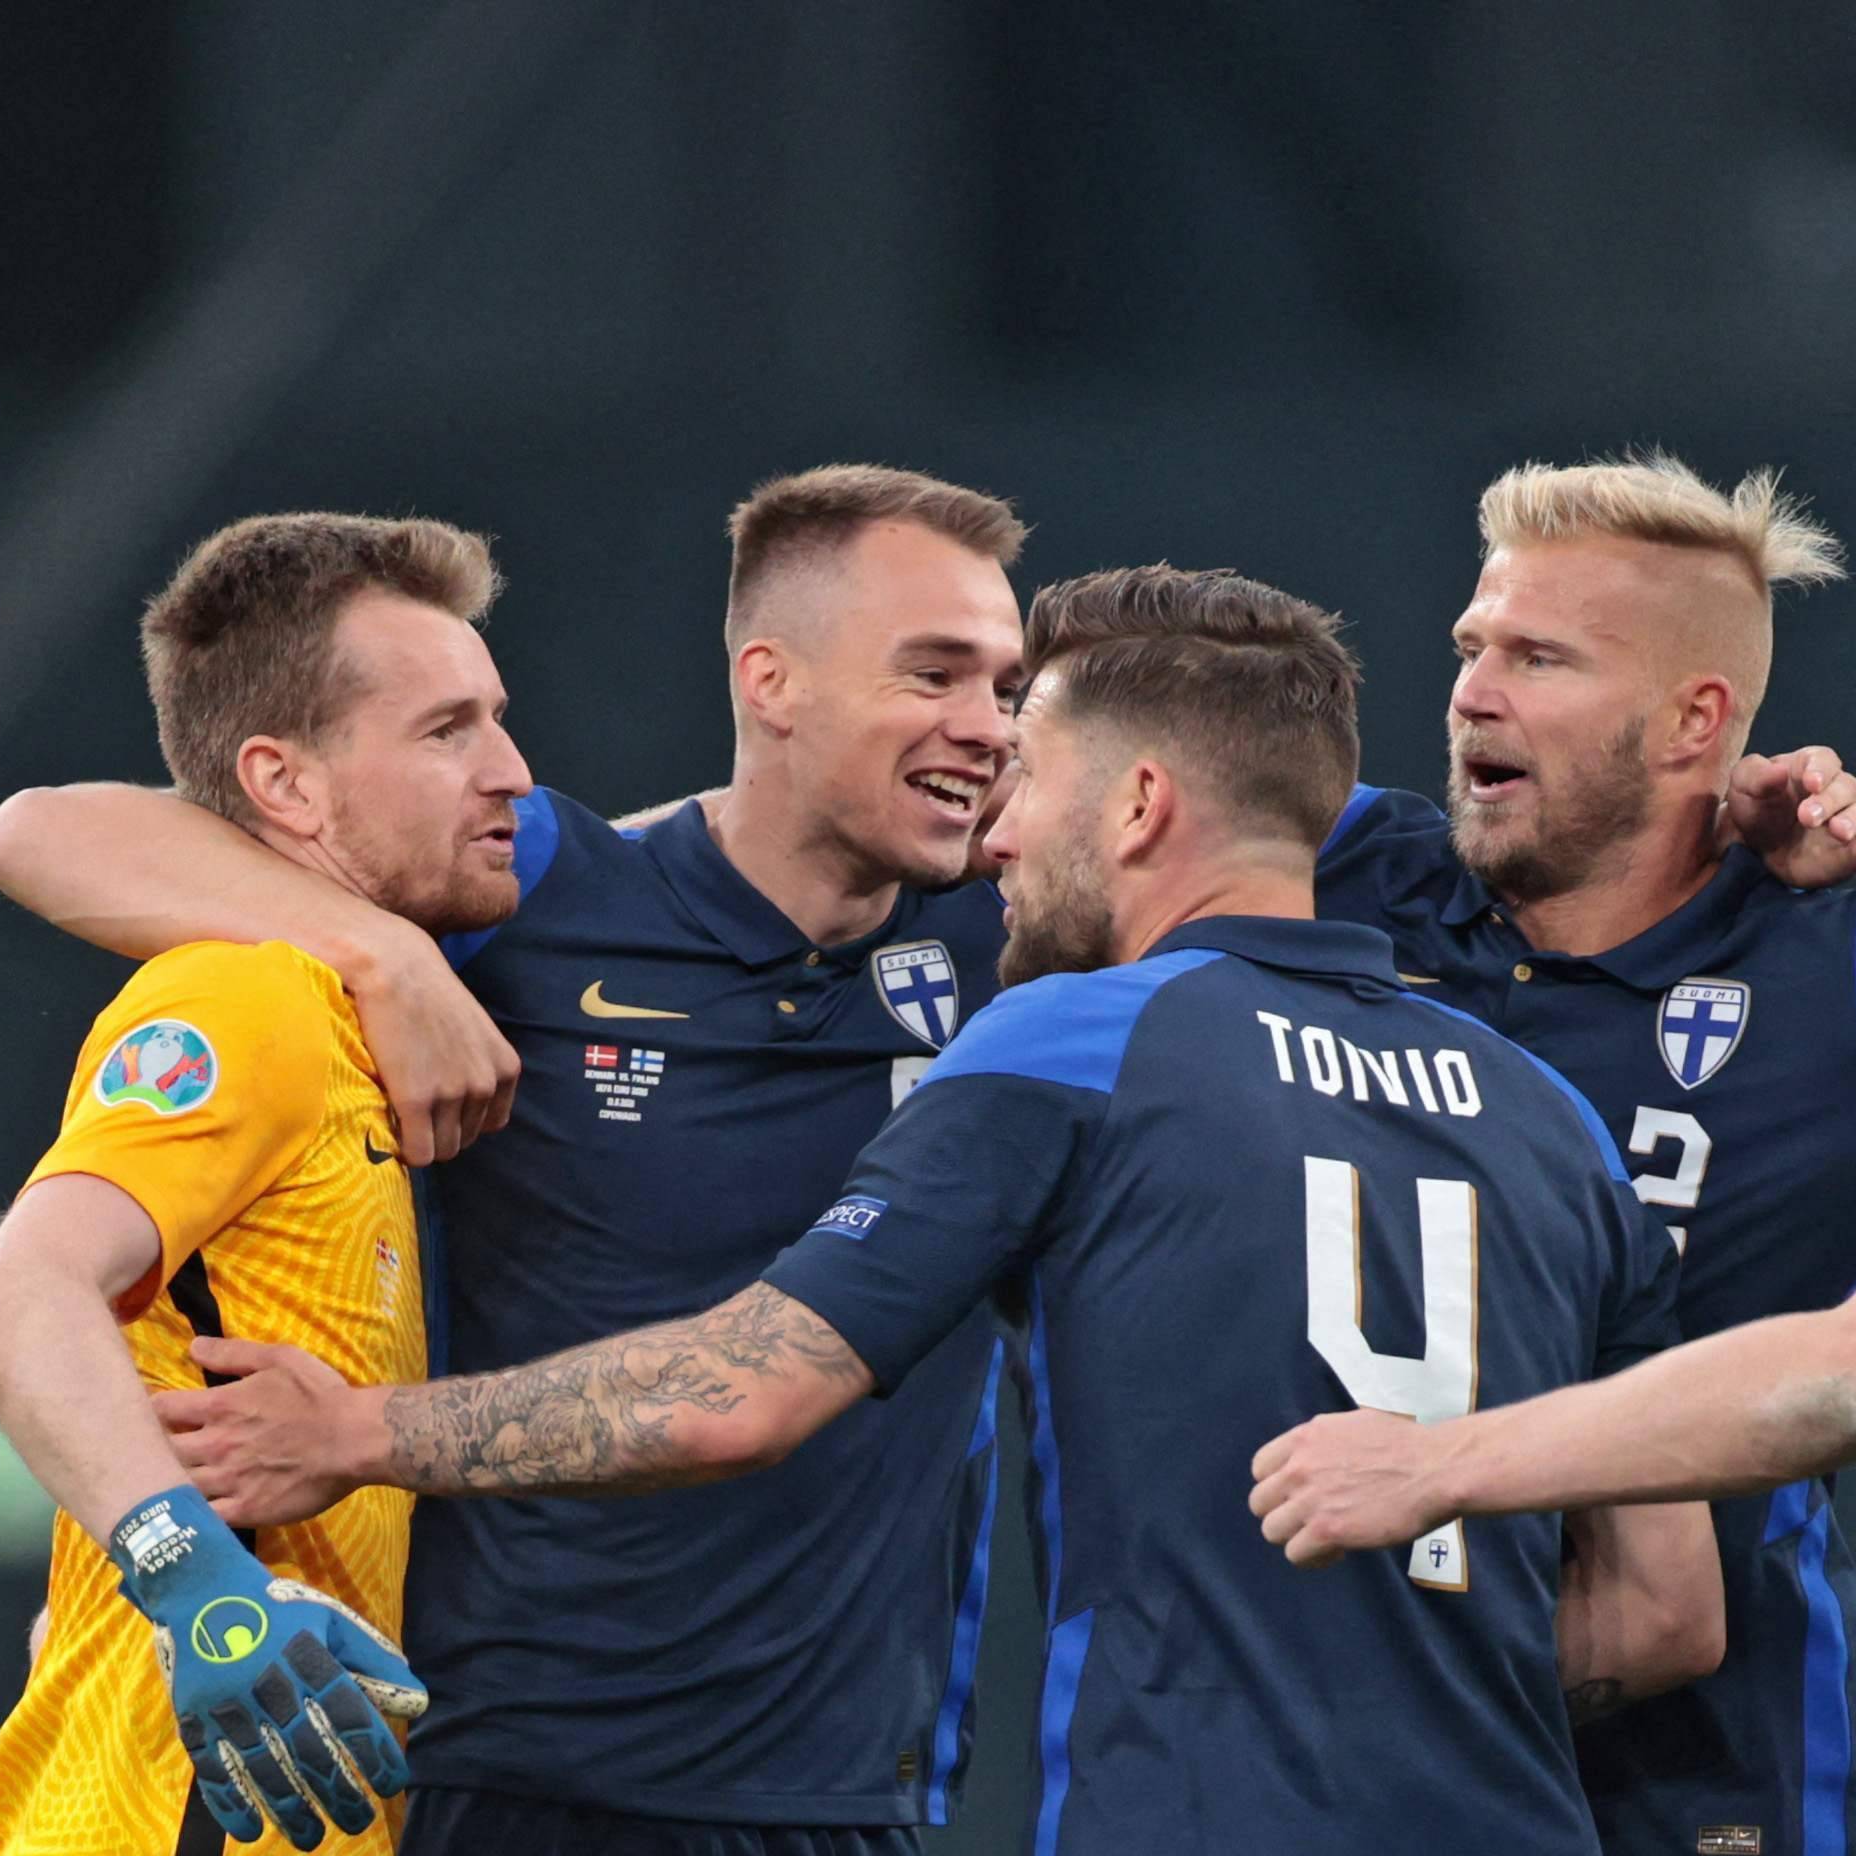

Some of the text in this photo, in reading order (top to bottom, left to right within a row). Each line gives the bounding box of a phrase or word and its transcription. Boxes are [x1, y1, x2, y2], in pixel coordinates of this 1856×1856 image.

[887, 951, 939, 967] SUOMI
[1679, 988, 1736, 1000] SUOMI
[814, 1205, 880, 1228] SPECT
[1304, 1156, 1478, 1592] 4
[147, 1541, 193, 1574] Lukas
